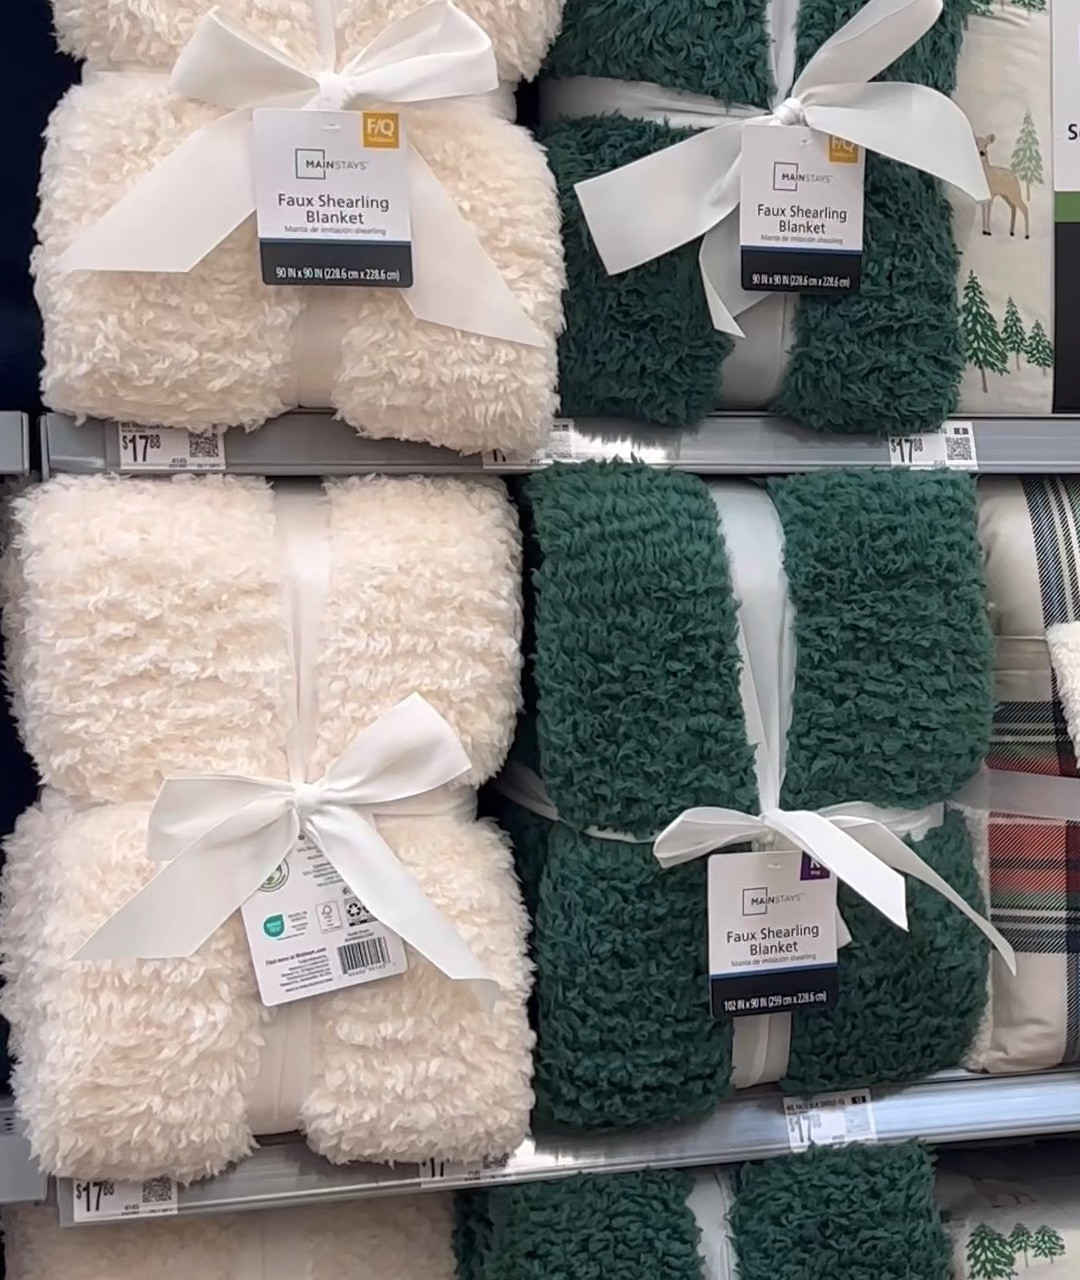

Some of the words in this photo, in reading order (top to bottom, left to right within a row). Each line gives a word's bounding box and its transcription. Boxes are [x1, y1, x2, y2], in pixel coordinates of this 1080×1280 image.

[366, 118, 394, 137] F/Q
[278, 193, 314, 207] Faux
[318, 194, 389, 212] Shearling
[306, 210, 364, 225] Blanket
[757, 204, 786, 218] Faux
[789, 206, 847, 223] Shearling
[779, 220, 825, 235] Blanket
[727, 931, 757, 943] Faux
[761, 924, 819, 941] Shearling
[751, 941, 798, 956] Blanket
